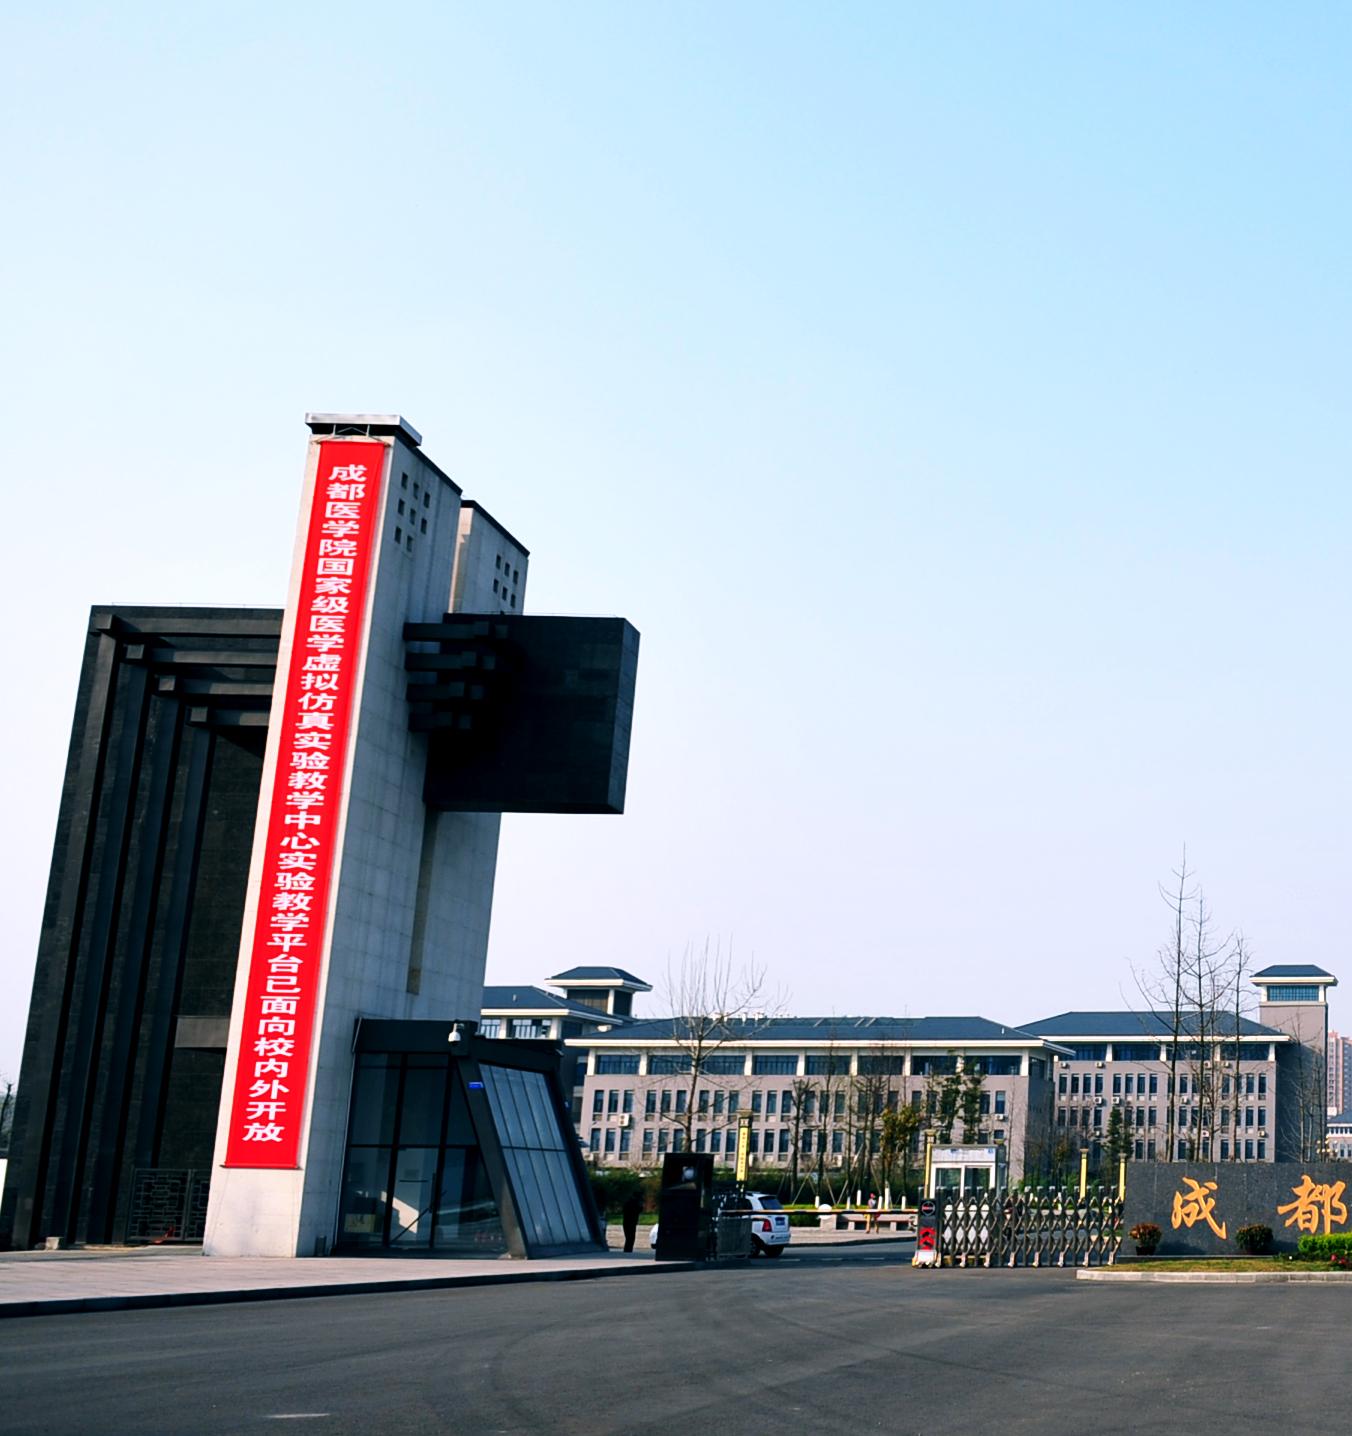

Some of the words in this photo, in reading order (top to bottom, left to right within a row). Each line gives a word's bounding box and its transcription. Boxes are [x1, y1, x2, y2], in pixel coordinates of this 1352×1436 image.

[243, 464, 367, 1142] 成都医学院国家级医学虚拟仿真实验教学中心实验教学平台已面向校内外开放
